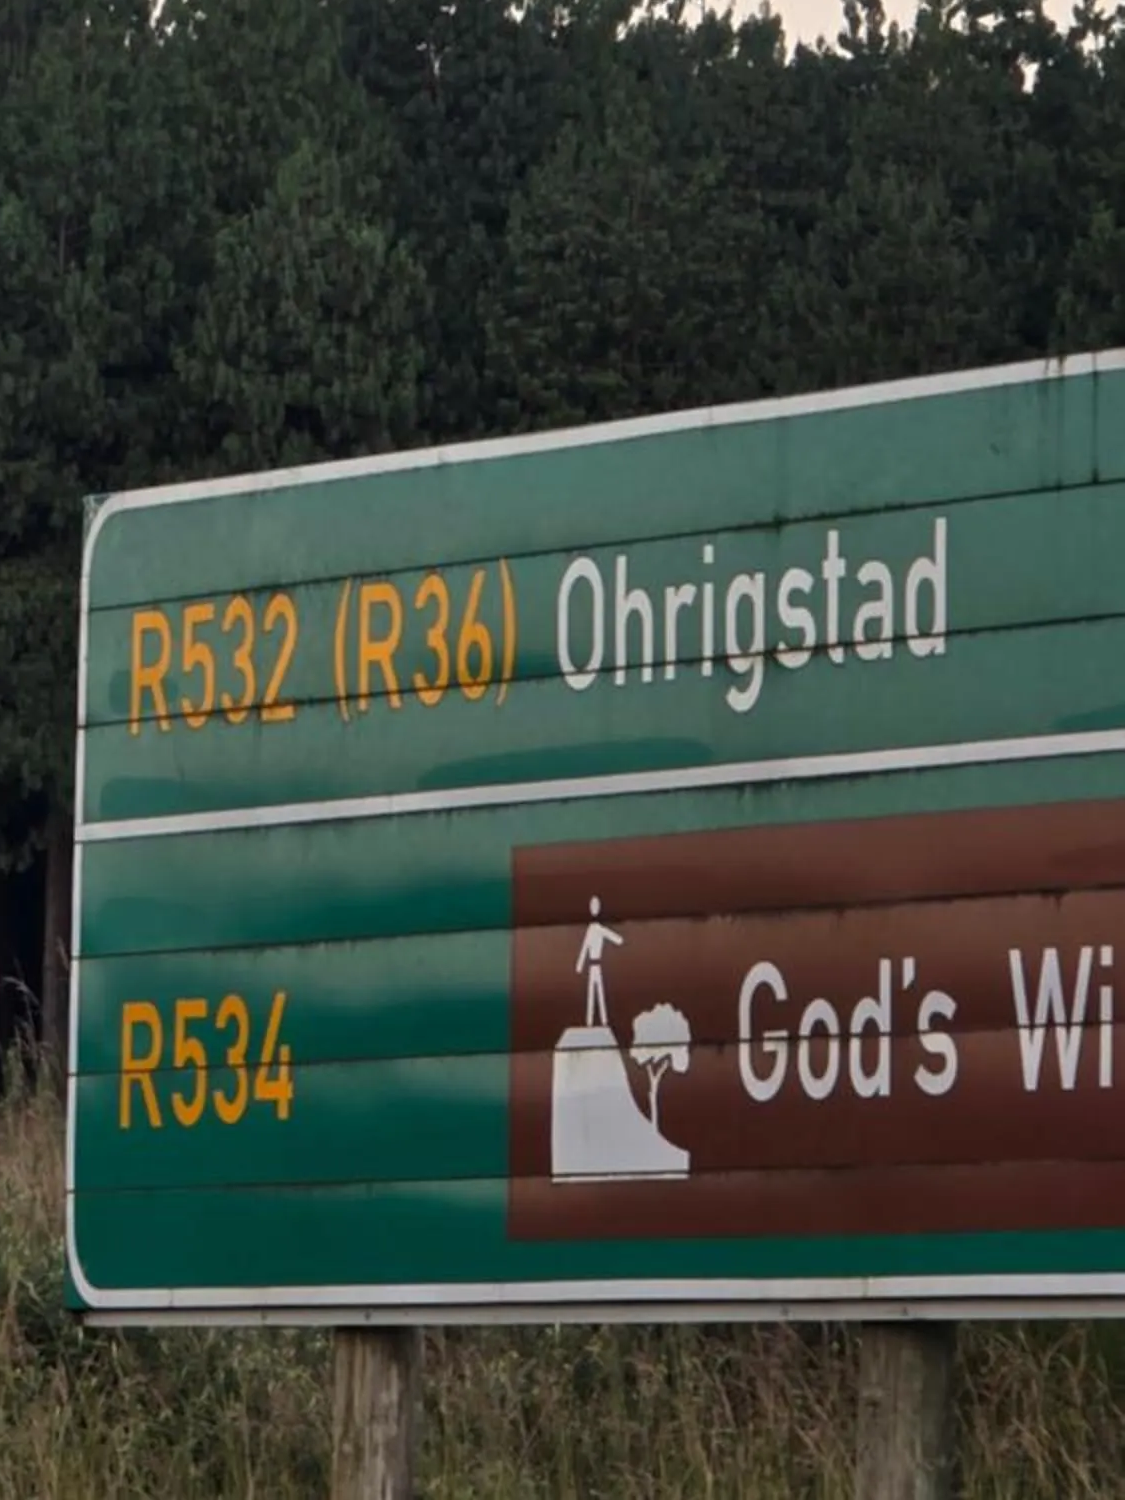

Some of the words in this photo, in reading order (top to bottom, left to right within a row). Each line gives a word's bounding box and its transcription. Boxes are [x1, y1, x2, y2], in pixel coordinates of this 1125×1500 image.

[128, 593, 299, 737] R532
[334, 556, 516, 724] (R36)
[556, 516, 948, 713] Ohrigstad
[118, 990, 294, 1129] R534
[737, 955, 959, 1102] God's
[1008, 944, 1115, 1092] Wi
